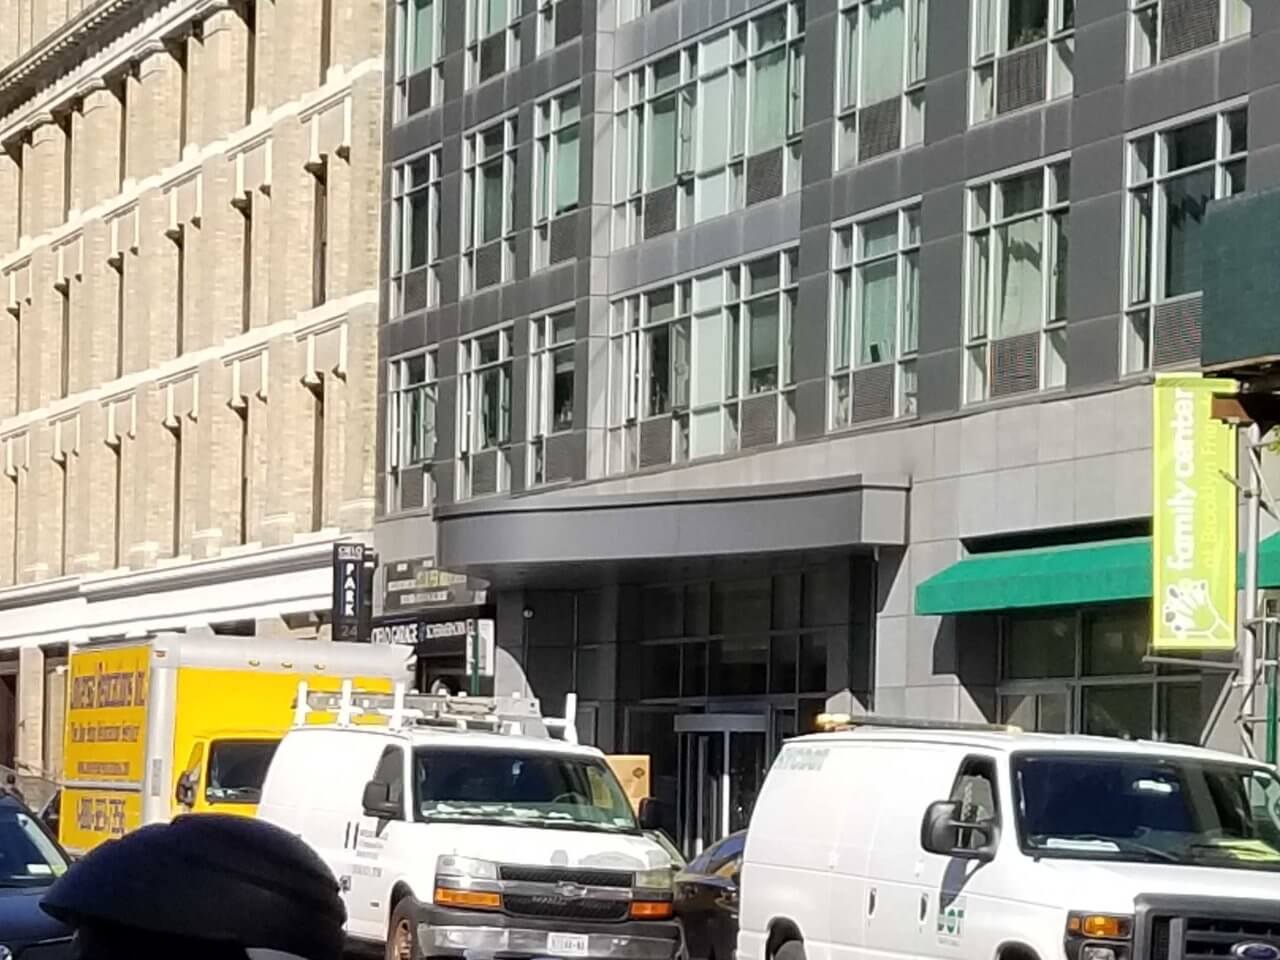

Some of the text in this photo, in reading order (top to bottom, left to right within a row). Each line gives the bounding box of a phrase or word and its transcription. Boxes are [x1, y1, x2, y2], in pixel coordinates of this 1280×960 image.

[1167, 387, 1198, 571] family center
[1200, 461, 1221, 543] Brooklyn
[344, 563, 356, 616] PARK
[340, 625, 358, 637] 24
